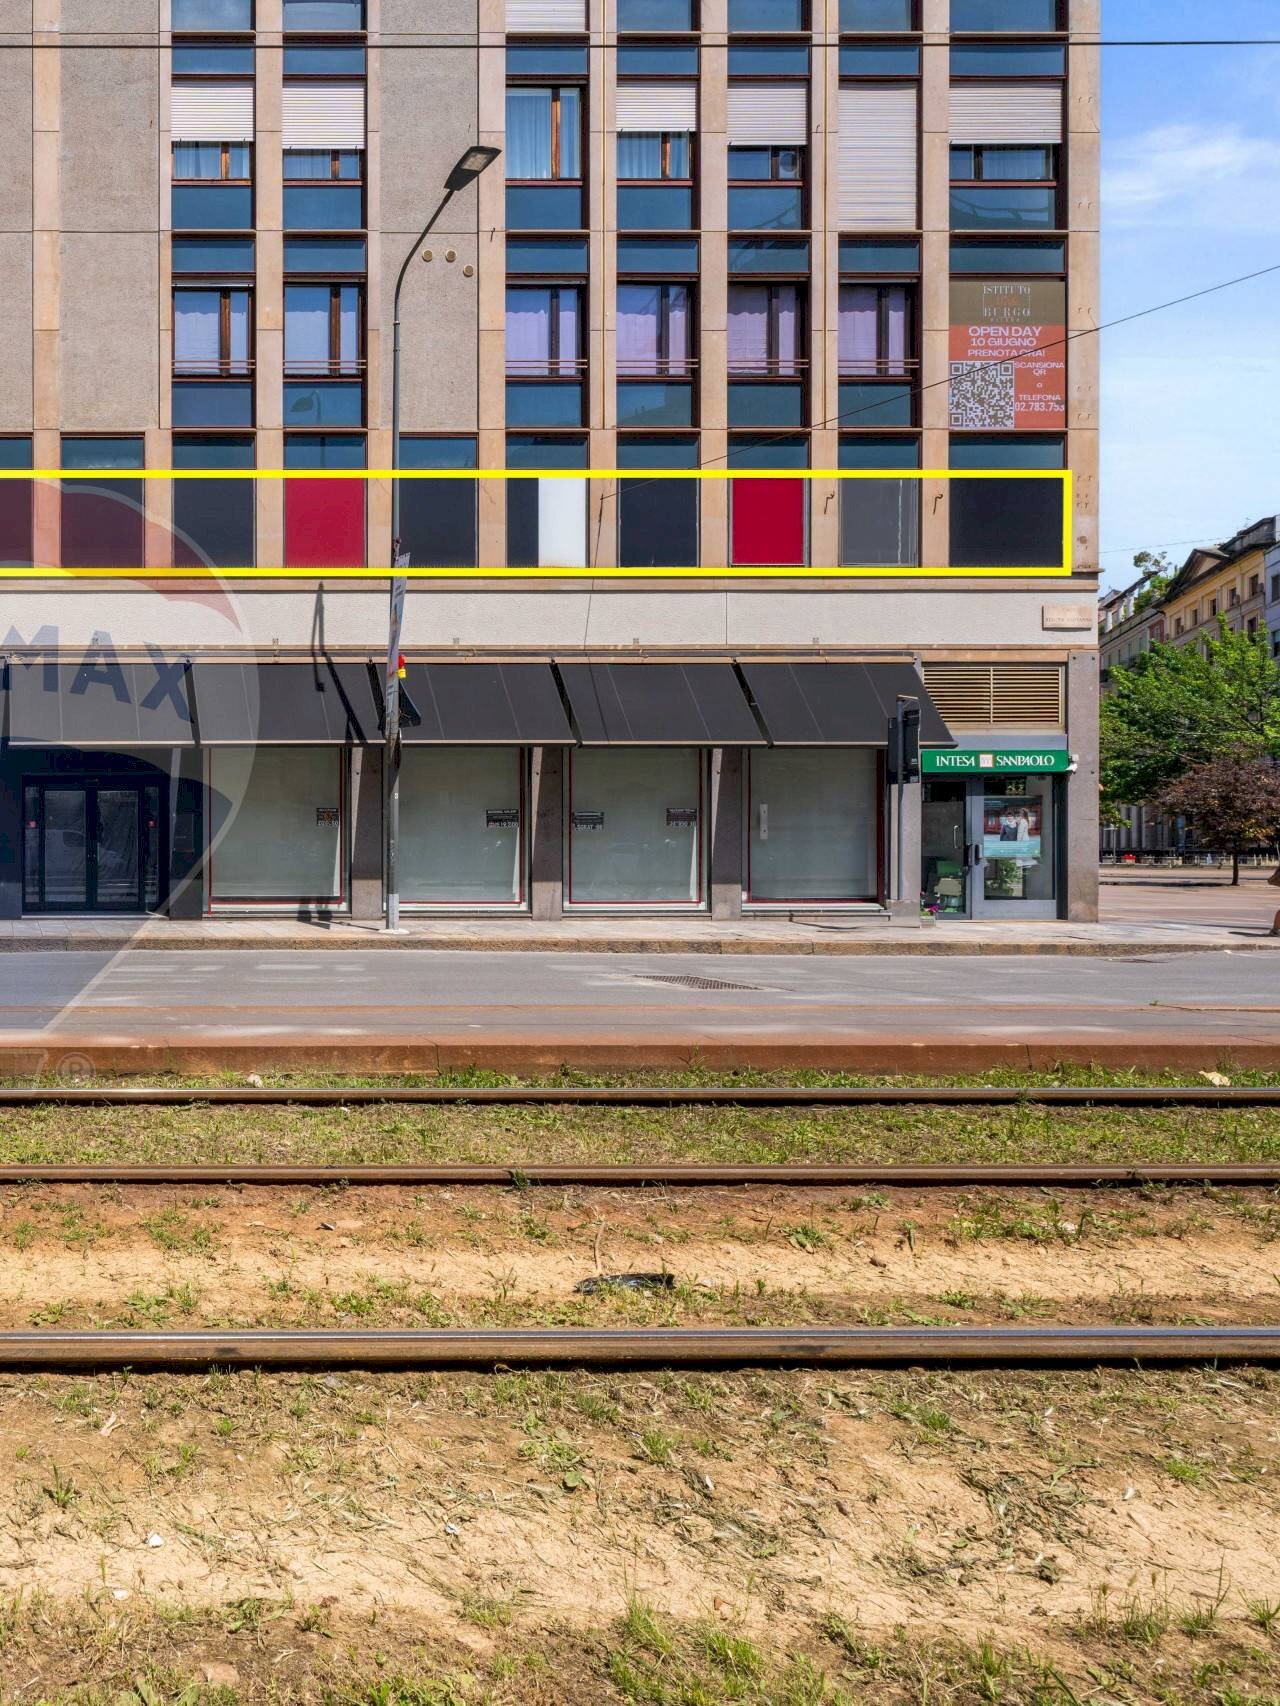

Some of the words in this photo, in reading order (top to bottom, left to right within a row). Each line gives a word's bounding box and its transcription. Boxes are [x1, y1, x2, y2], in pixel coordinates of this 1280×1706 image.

[983, 285, 1030, 294] ISTITUTO
[968, 326, 1009, 337] OPEN
[1011, 326, 1042, 337] DAY
[970, 337, 986, 347] 10
[987, 337, 1037, 347] GIUGNO
[967, 349, 1017, 357] PRENOTA
[935, 755, 976, 767] INTESA
[996, 755, 1055, 767] SANPAOLO
